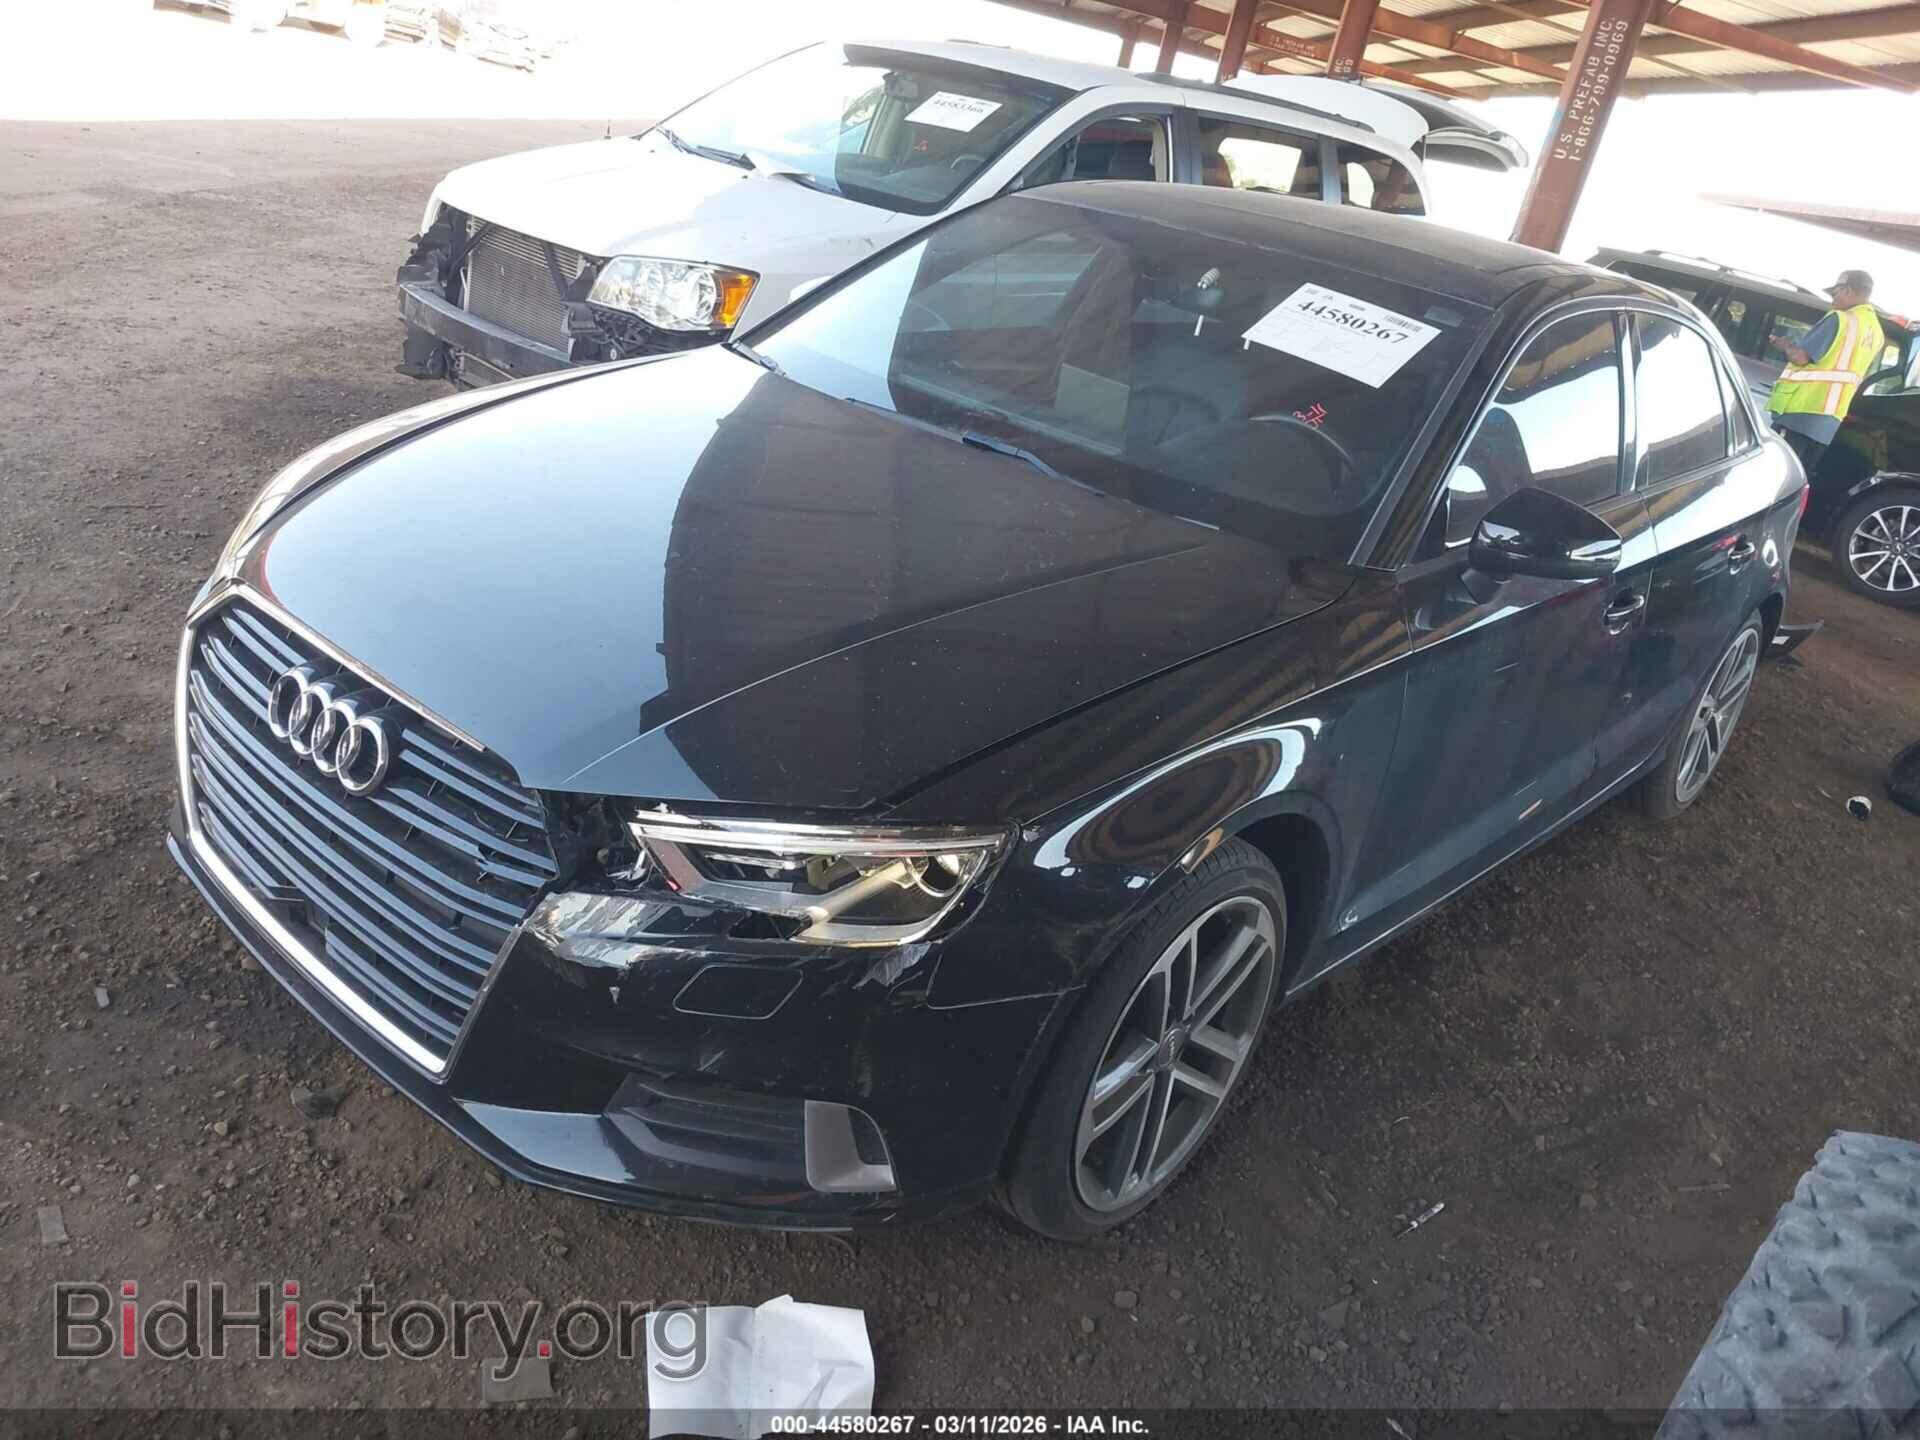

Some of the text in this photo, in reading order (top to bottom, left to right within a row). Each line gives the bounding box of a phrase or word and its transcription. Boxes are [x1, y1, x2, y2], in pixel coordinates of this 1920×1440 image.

[1553, 17, 1616, 159] U.S. PREFAB INC.
[1569, 20, 1628, 161] 1-866-799-0969
[1298, 300, 1409, 344] 44580267
